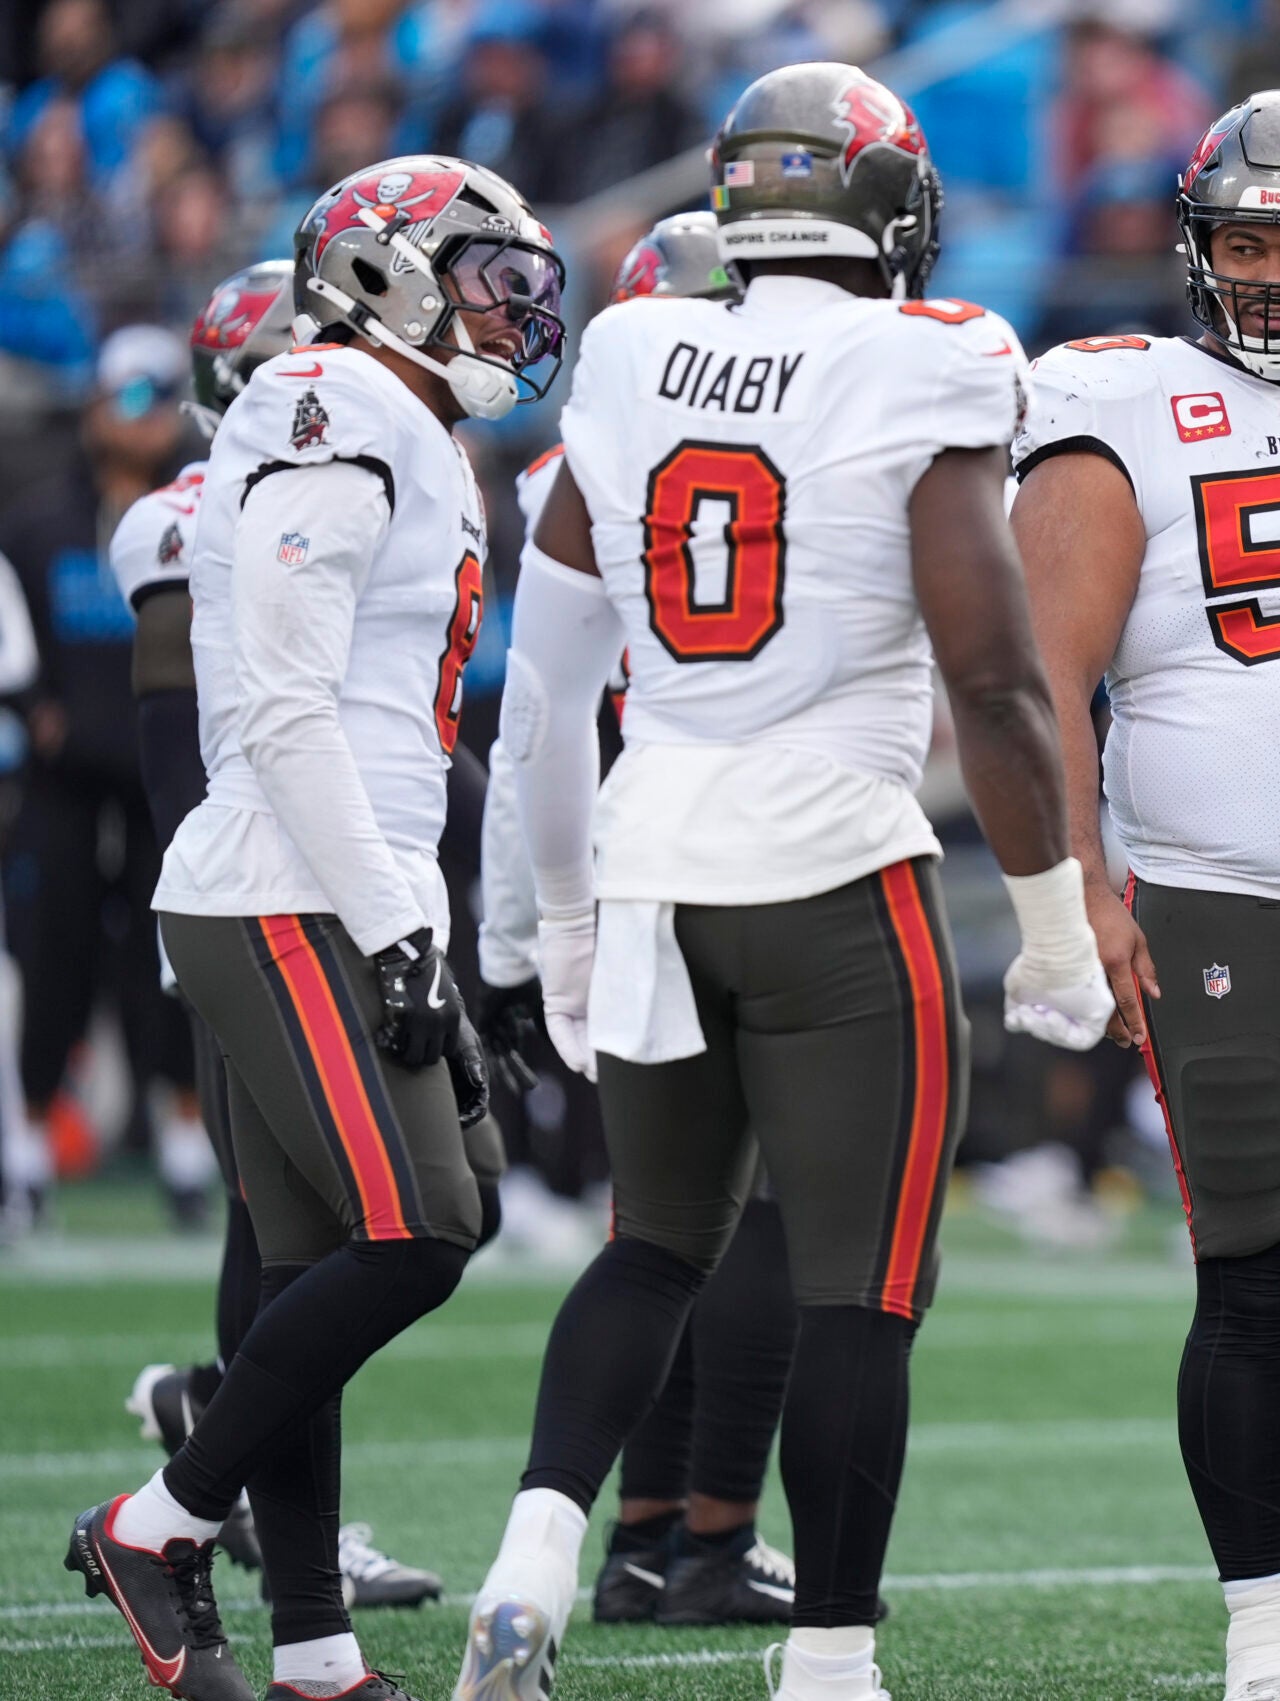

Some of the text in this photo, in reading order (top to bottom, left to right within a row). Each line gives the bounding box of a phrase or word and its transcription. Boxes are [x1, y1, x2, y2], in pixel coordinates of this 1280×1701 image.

[658, 341, 804, 414] DIABY
[1176, 396, 1224, 429] C
[280, 545, 302, 563] NFL
[640, 438, 788, 664] 0
[1208, 978, 1228, 993] NFL
[79, 1535, 101, 1576] VAPOR
